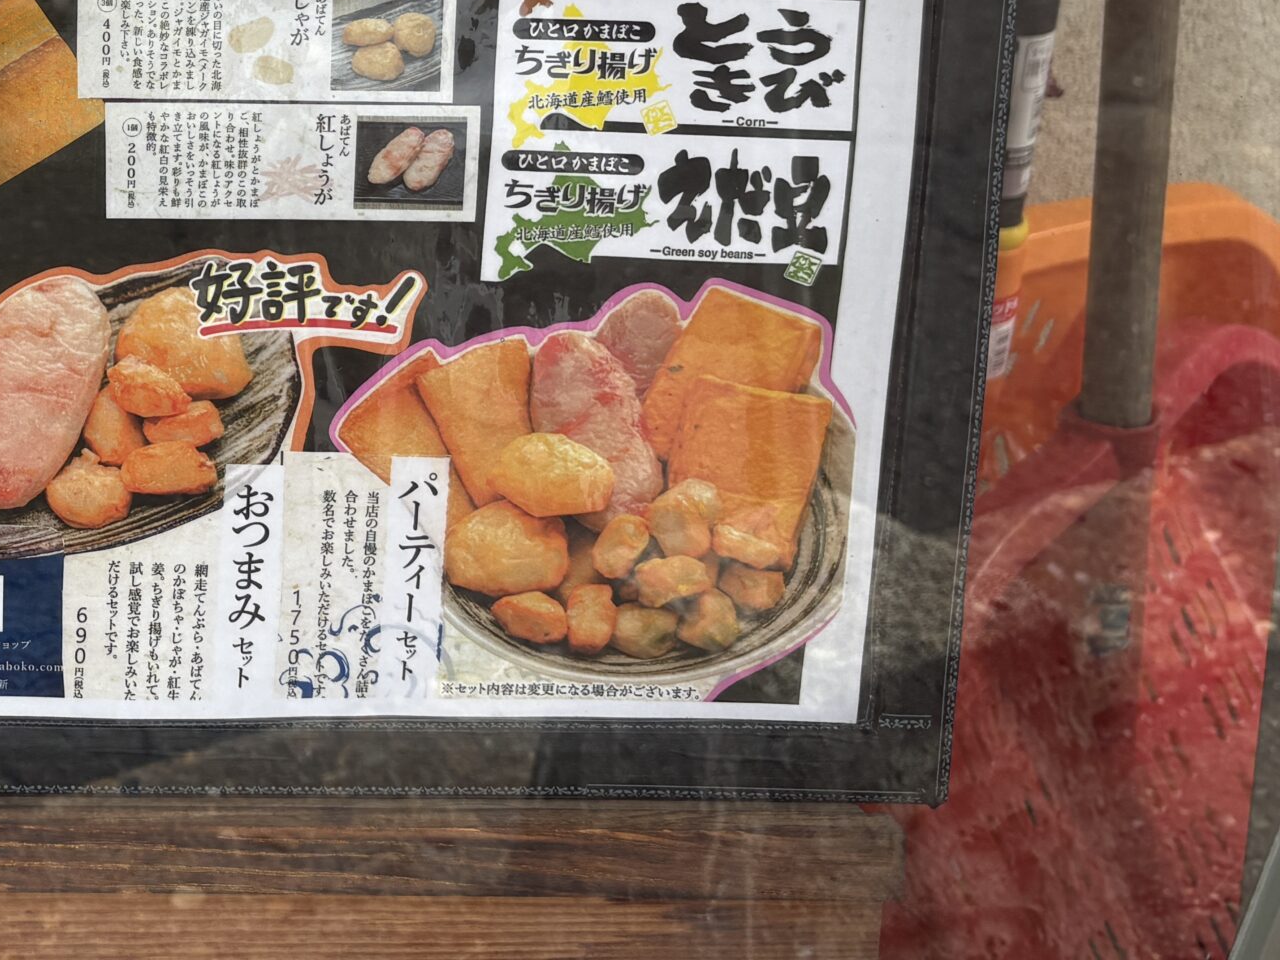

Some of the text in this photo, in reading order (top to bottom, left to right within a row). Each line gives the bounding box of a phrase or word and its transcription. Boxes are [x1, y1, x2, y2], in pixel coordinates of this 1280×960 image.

[514, 44, 657, 80] ちぎり揚げ
[314, 114, 336, 205] 紅しょうが
[504, 178, 647, 215] ちぎり揚げ
[658, 148, 831, 255] えだ豆
